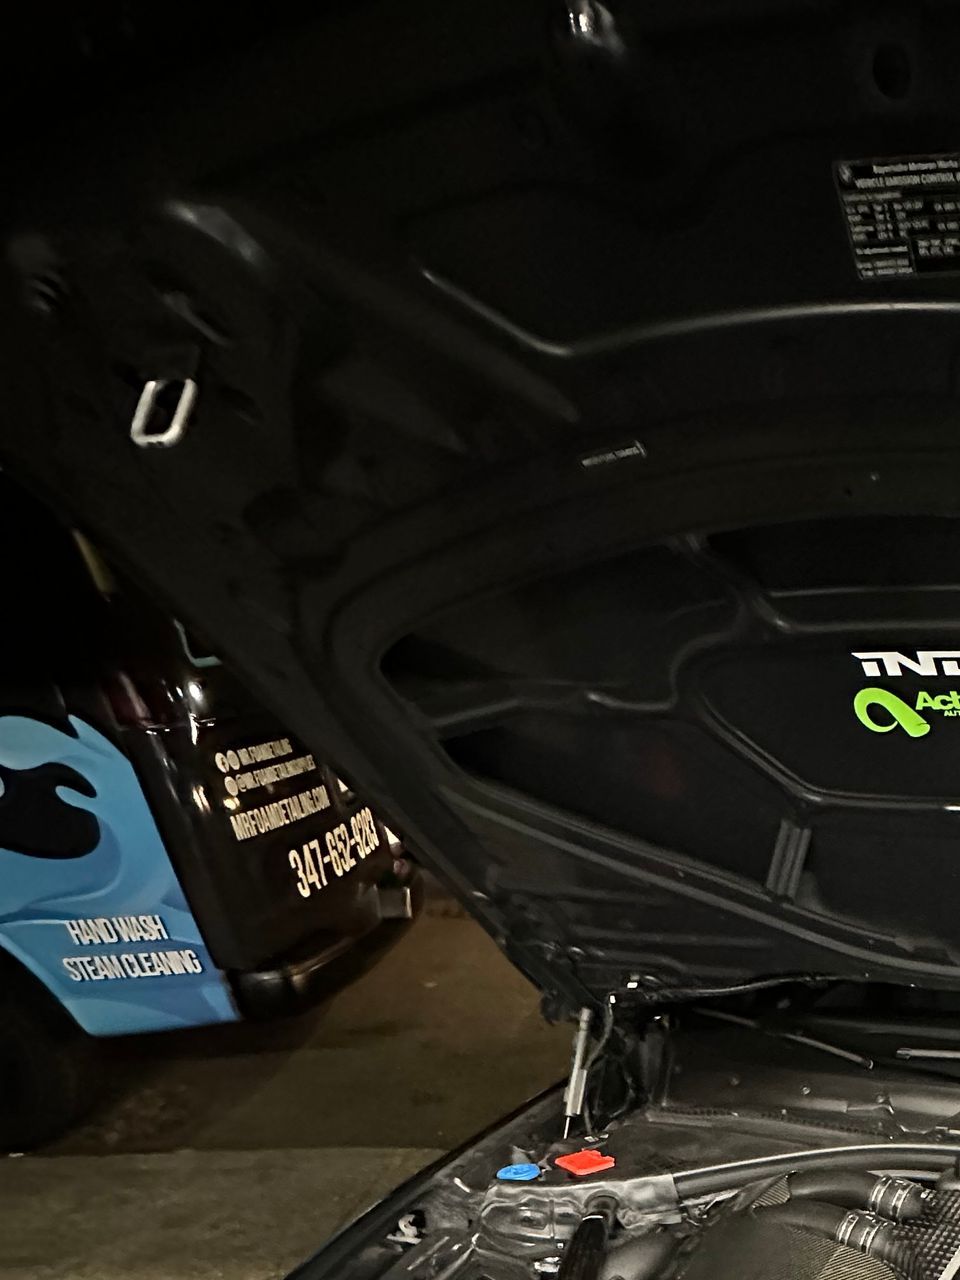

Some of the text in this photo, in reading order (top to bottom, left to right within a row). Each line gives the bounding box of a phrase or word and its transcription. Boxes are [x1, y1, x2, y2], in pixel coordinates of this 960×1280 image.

[288, 806, 380, 899] 347-652-9283
[65, 914, 169, 946] HAND WASH
[62, 949, 203, 982] STEAM CLEANING
